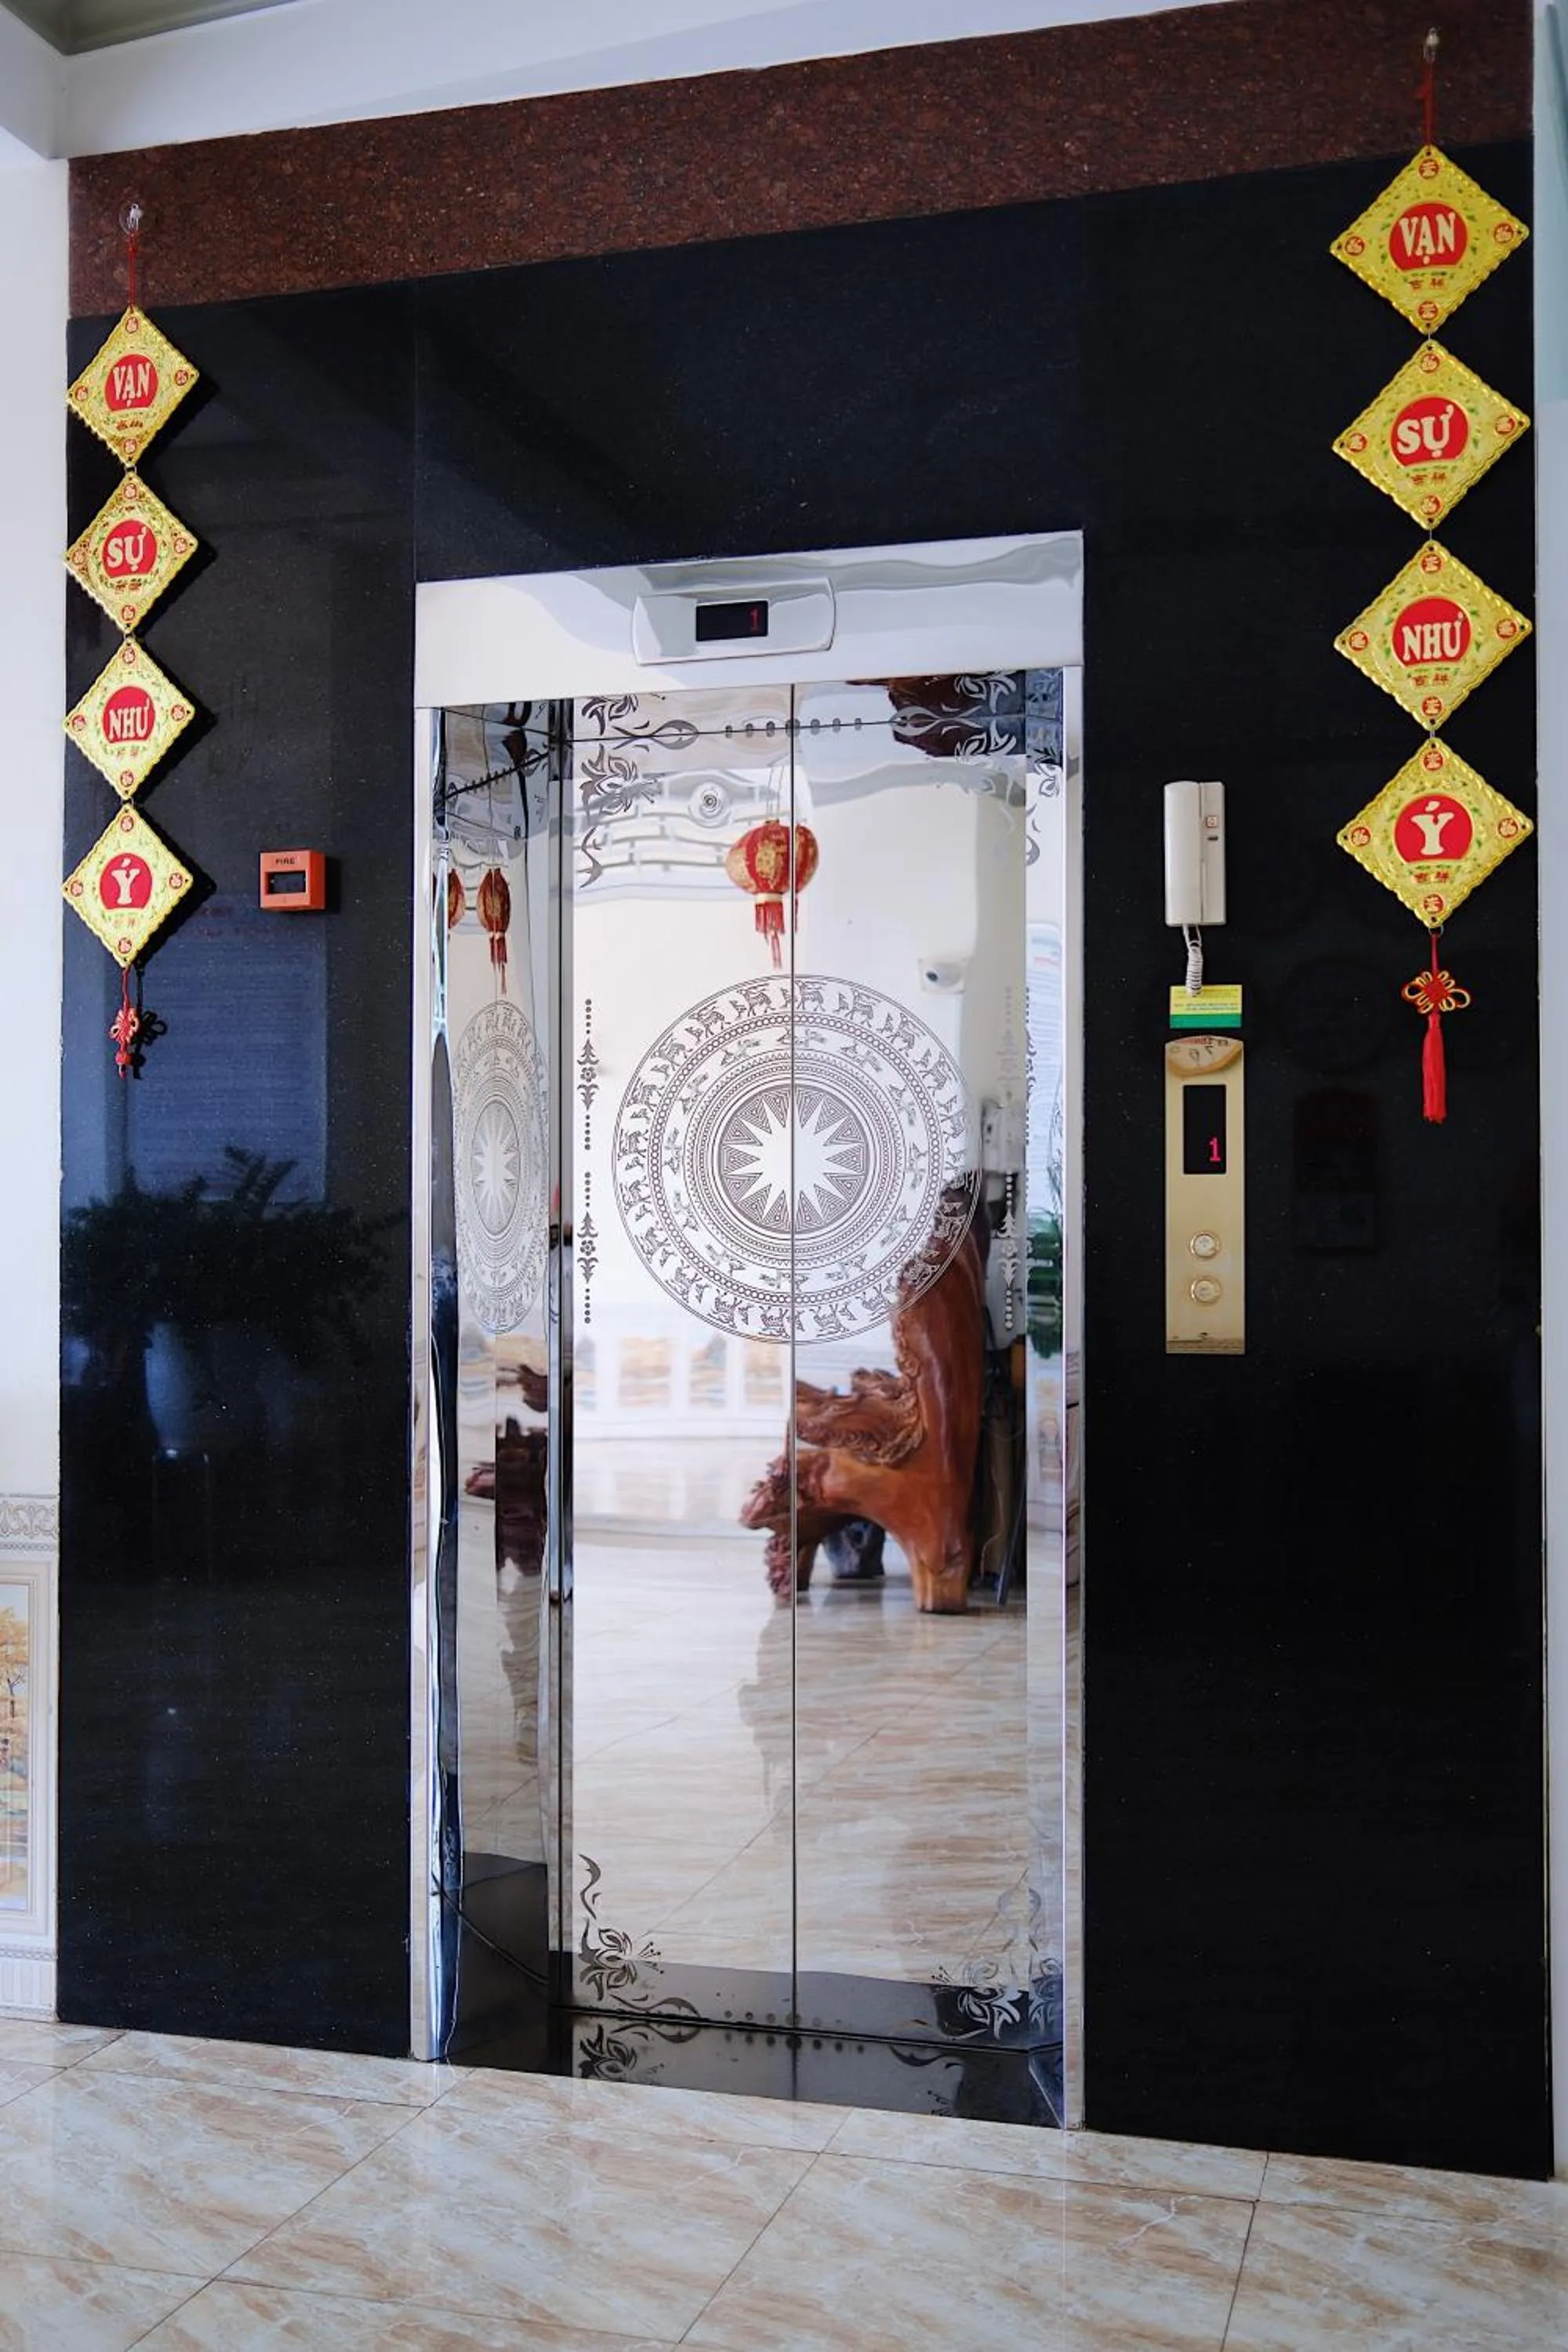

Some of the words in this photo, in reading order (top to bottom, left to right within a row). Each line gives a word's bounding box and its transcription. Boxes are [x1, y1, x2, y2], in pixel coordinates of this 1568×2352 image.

[1399, 212, 1456, 264] VẠN
[113, 362, 151, 407] VẠN
[1396, 404, 1454, 458] SỰ
[750, 607, 760, 632] 1
[1410, 800, 1455, 855] Ý
[111, 858, 140, 905] Ý
[275, 857, 296, 866] FIRE
[1209, 1136, 1222, 1162] 1
